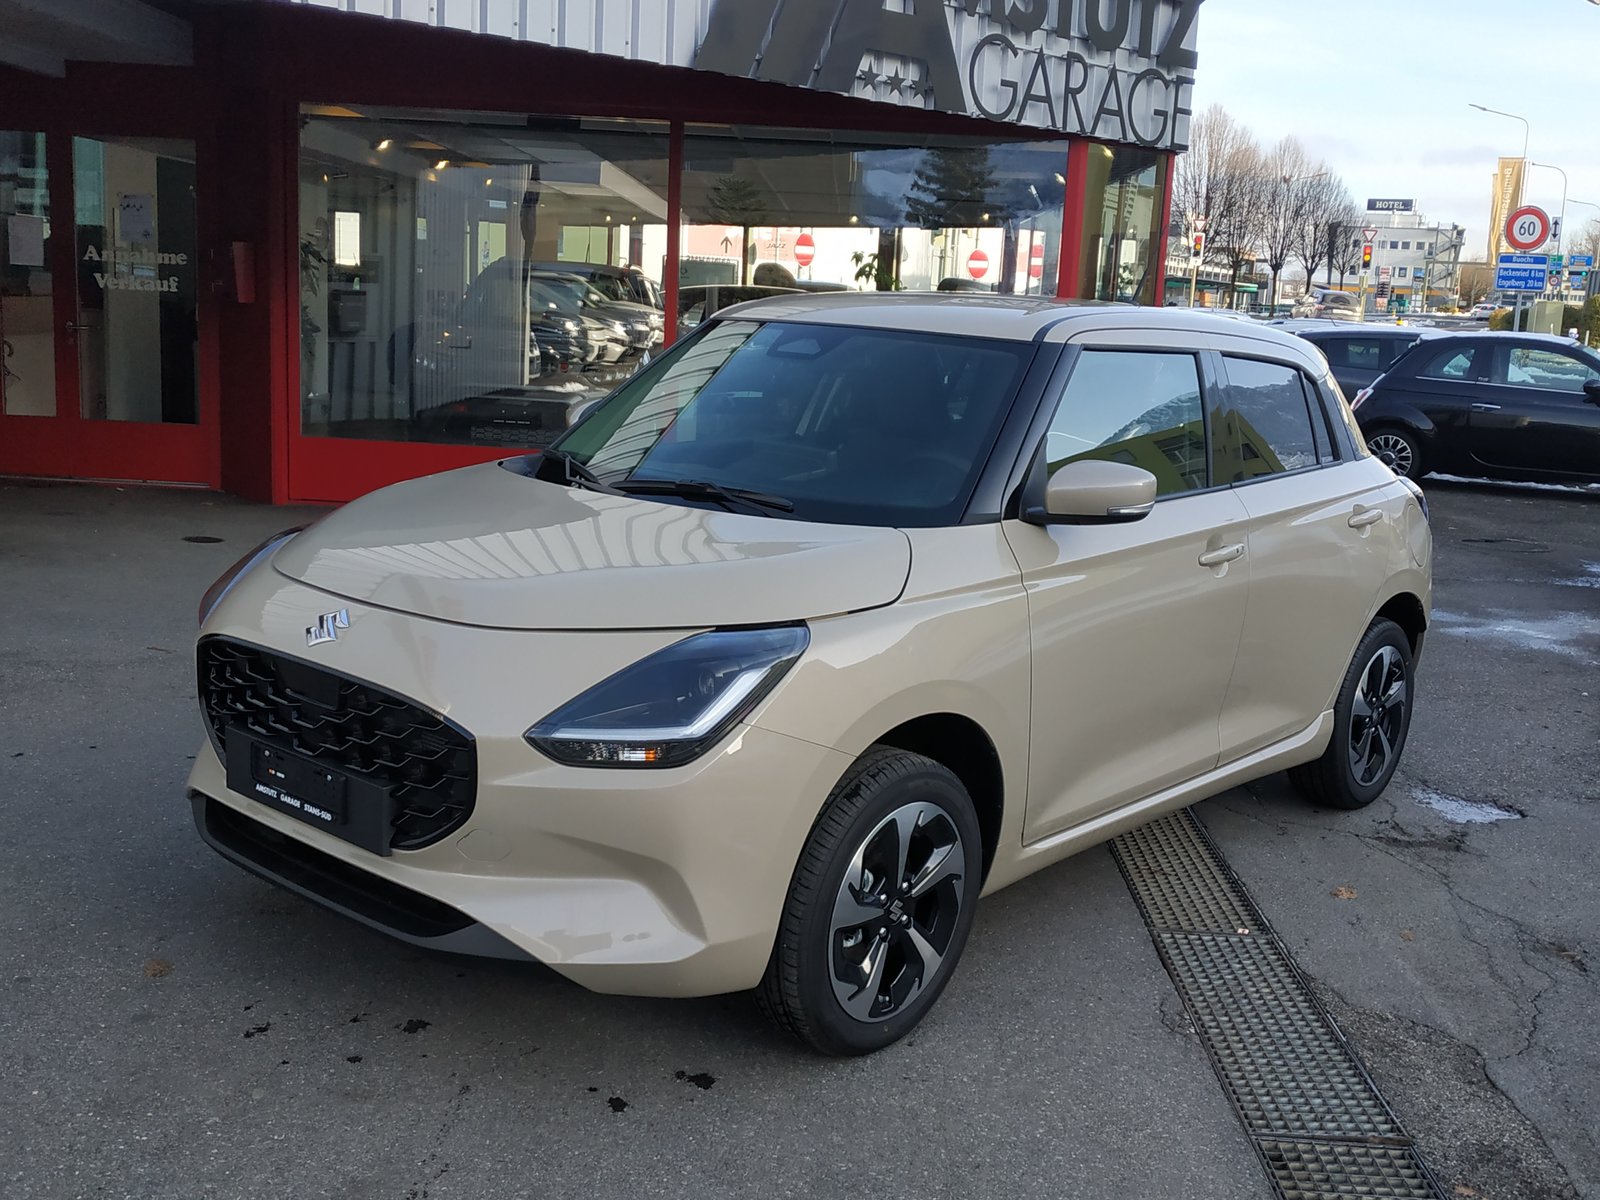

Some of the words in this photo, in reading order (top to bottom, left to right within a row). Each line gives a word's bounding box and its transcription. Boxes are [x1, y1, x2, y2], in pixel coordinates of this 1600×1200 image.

[969, 33, 1196, 150] GARAGE
[1376, 200, 1404, 209] HOTEL
[1518, 221, 1536, 236] 60
[83, 244, 188, 265] Annahme
[1499, 269, 1530, 277] Beckenried
[1536, 270, 1544, 278] km
[93, 273, 179, 292] Verkauf
[1498, 279, 1526, 288] Engelberg
[256, 783, 278, 798] AMSTUTZ
[280, 794, 301, 808] GARAGE
[304, 803, 332, 821] STANS-SÜD
